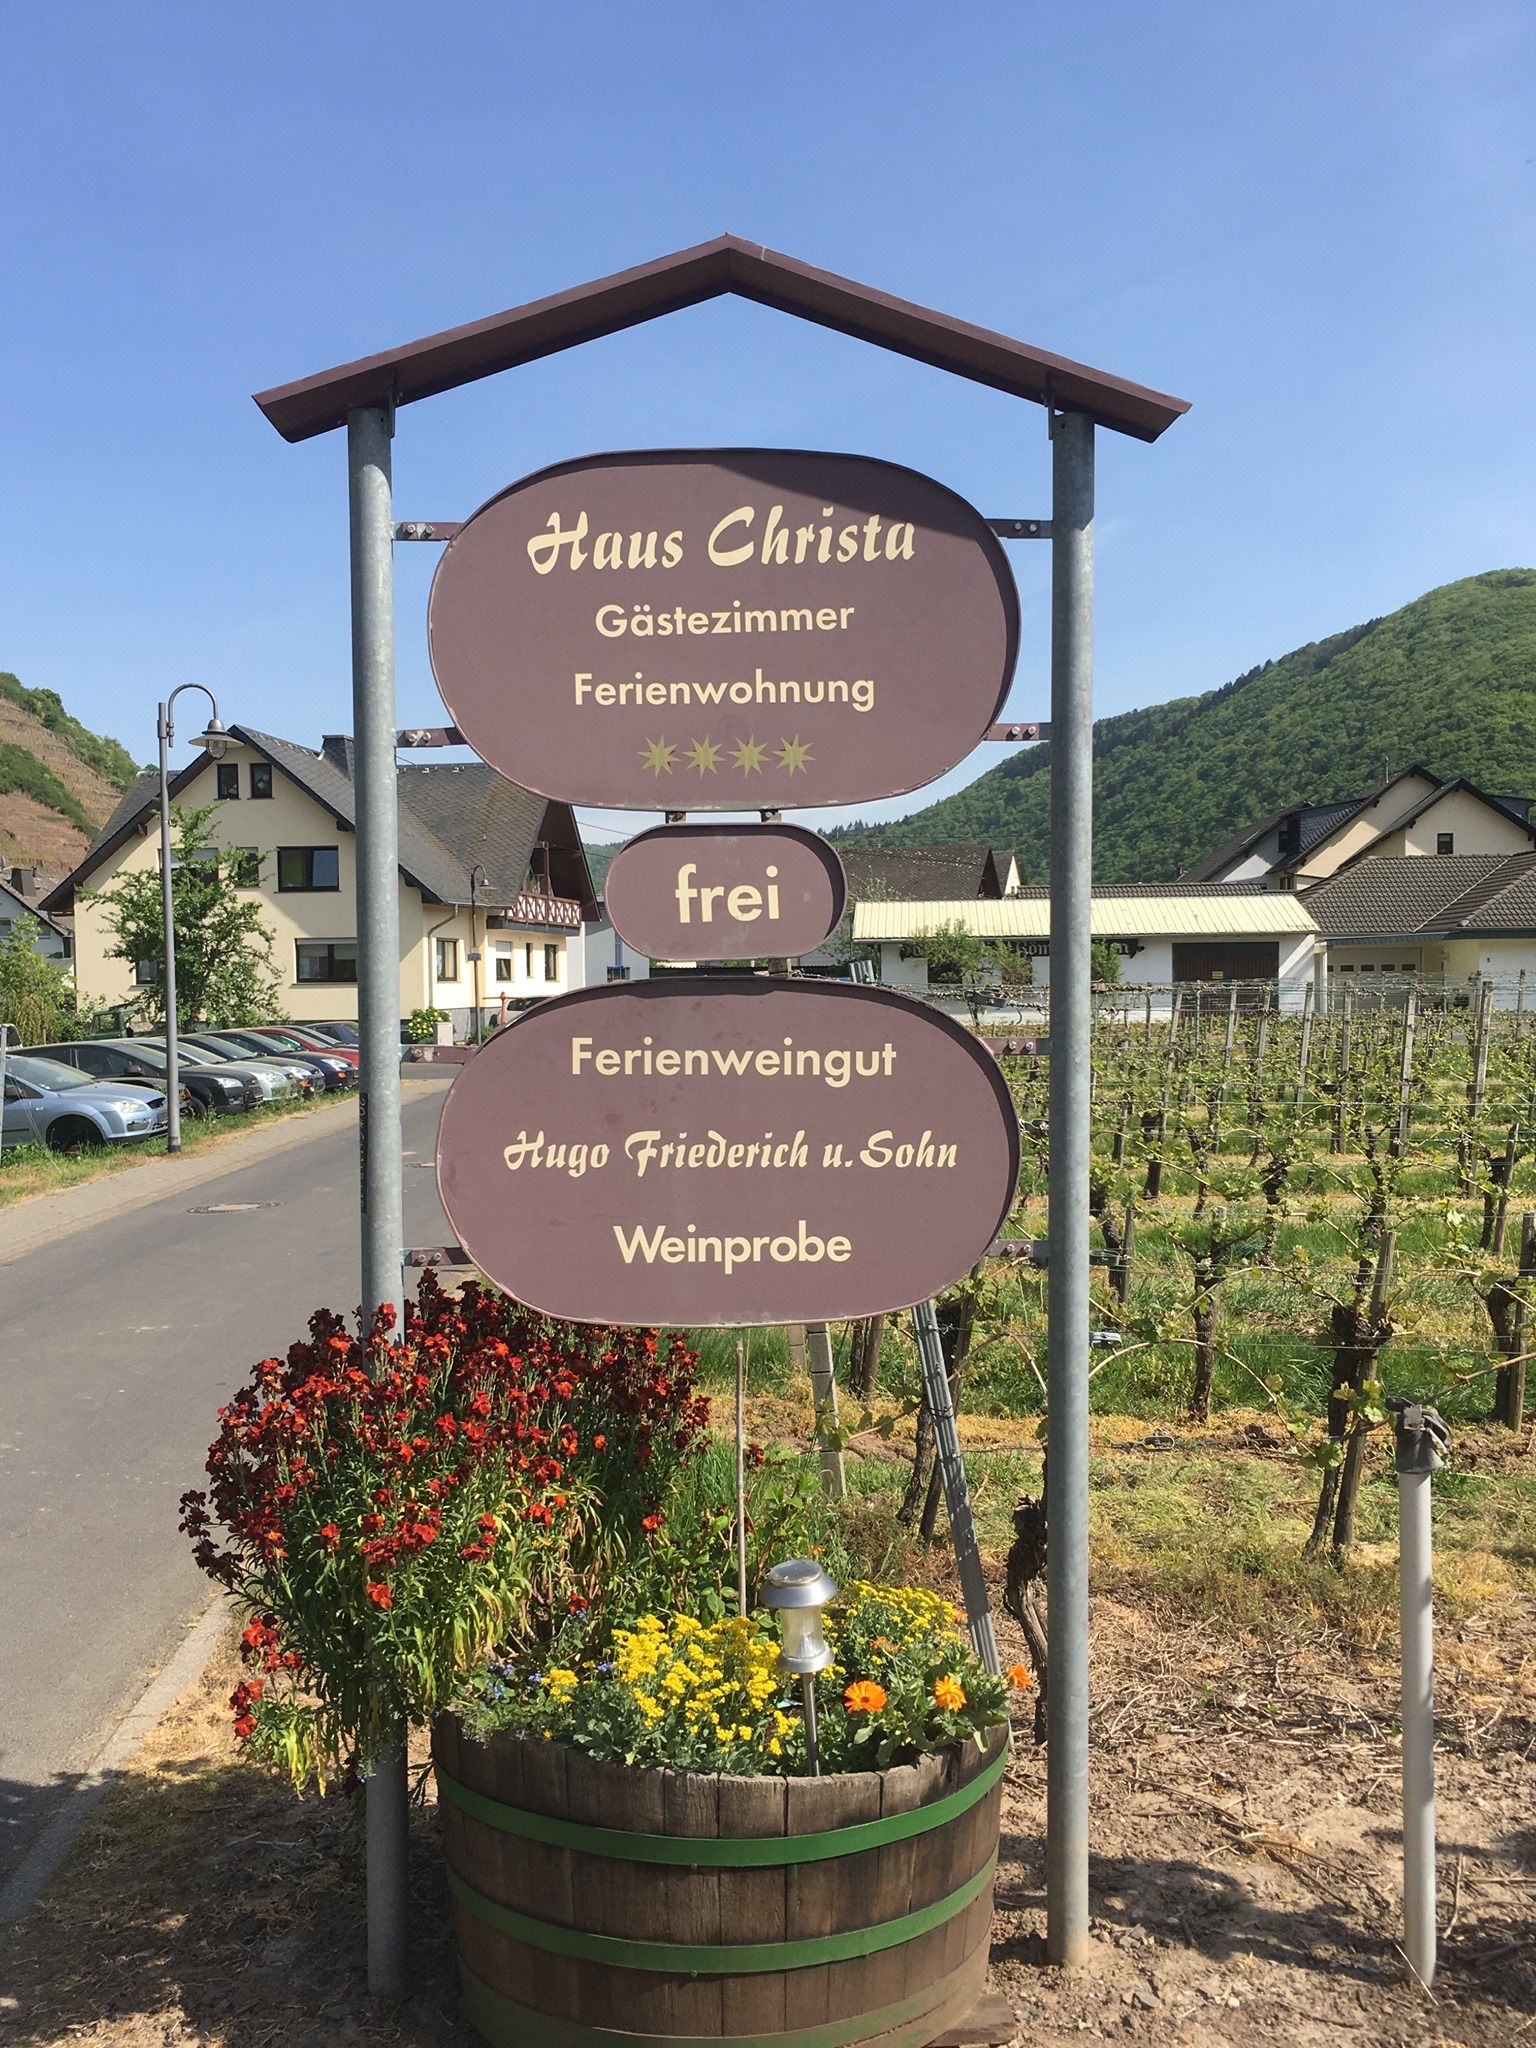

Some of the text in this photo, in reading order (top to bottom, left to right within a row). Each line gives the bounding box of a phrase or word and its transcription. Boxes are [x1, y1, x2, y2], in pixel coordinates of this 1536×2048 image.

[527, 505, 914, 575] Haus Christa
[595, 601, 855, 638] Gästezimmer
[574, 669, 874, 712] Ferienwohnung
[675, 864, 780, 923] frei
[571, 1037, 897, 1088] Ferienweingut
[504, 1131, 609, 1177] Hugo
[625, 1130, 808, 1178] Friederich
[613, 1220, 852, 1275] Weinprobe
